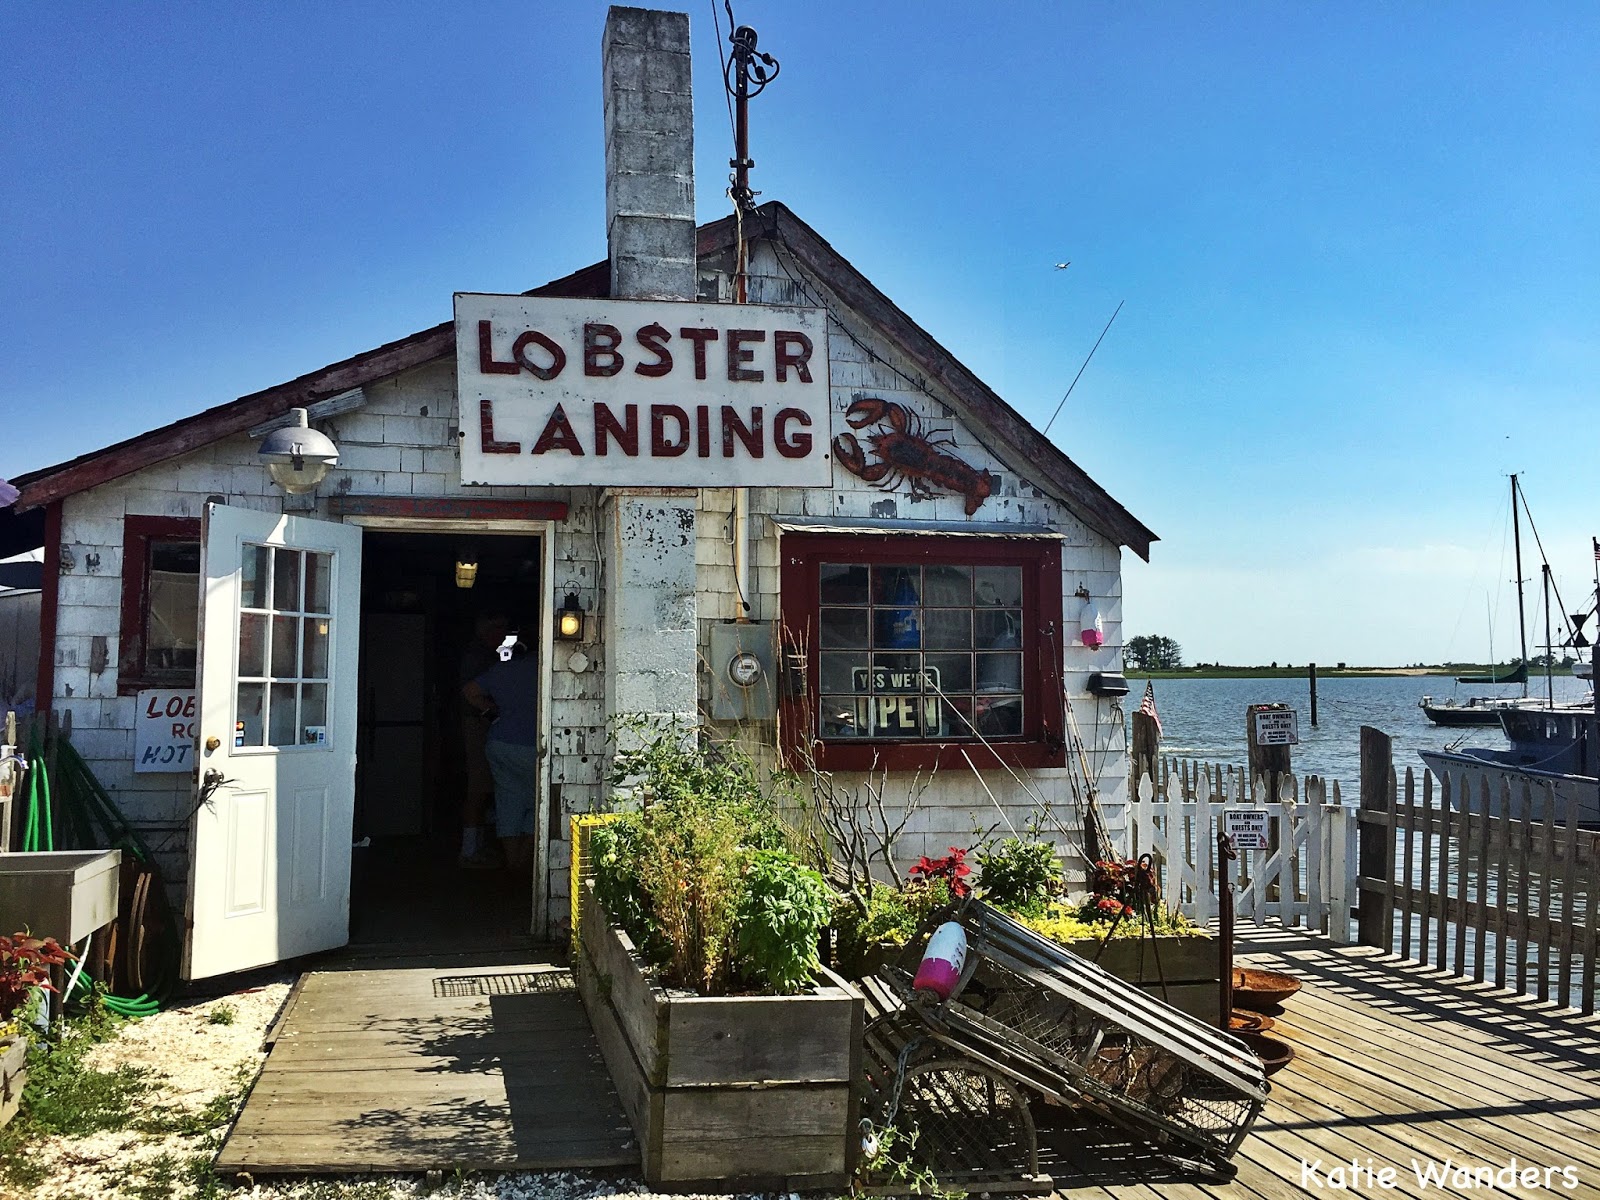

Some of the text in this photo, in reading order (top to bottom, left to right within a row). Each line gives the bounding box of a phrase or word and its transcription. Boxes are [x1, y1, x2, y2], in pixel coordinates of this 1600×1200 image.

[478, 319, 814, 384] LOBSTER
[480, 399, 813, 459] LANDING
[141, 744, 192, 765] HOT
